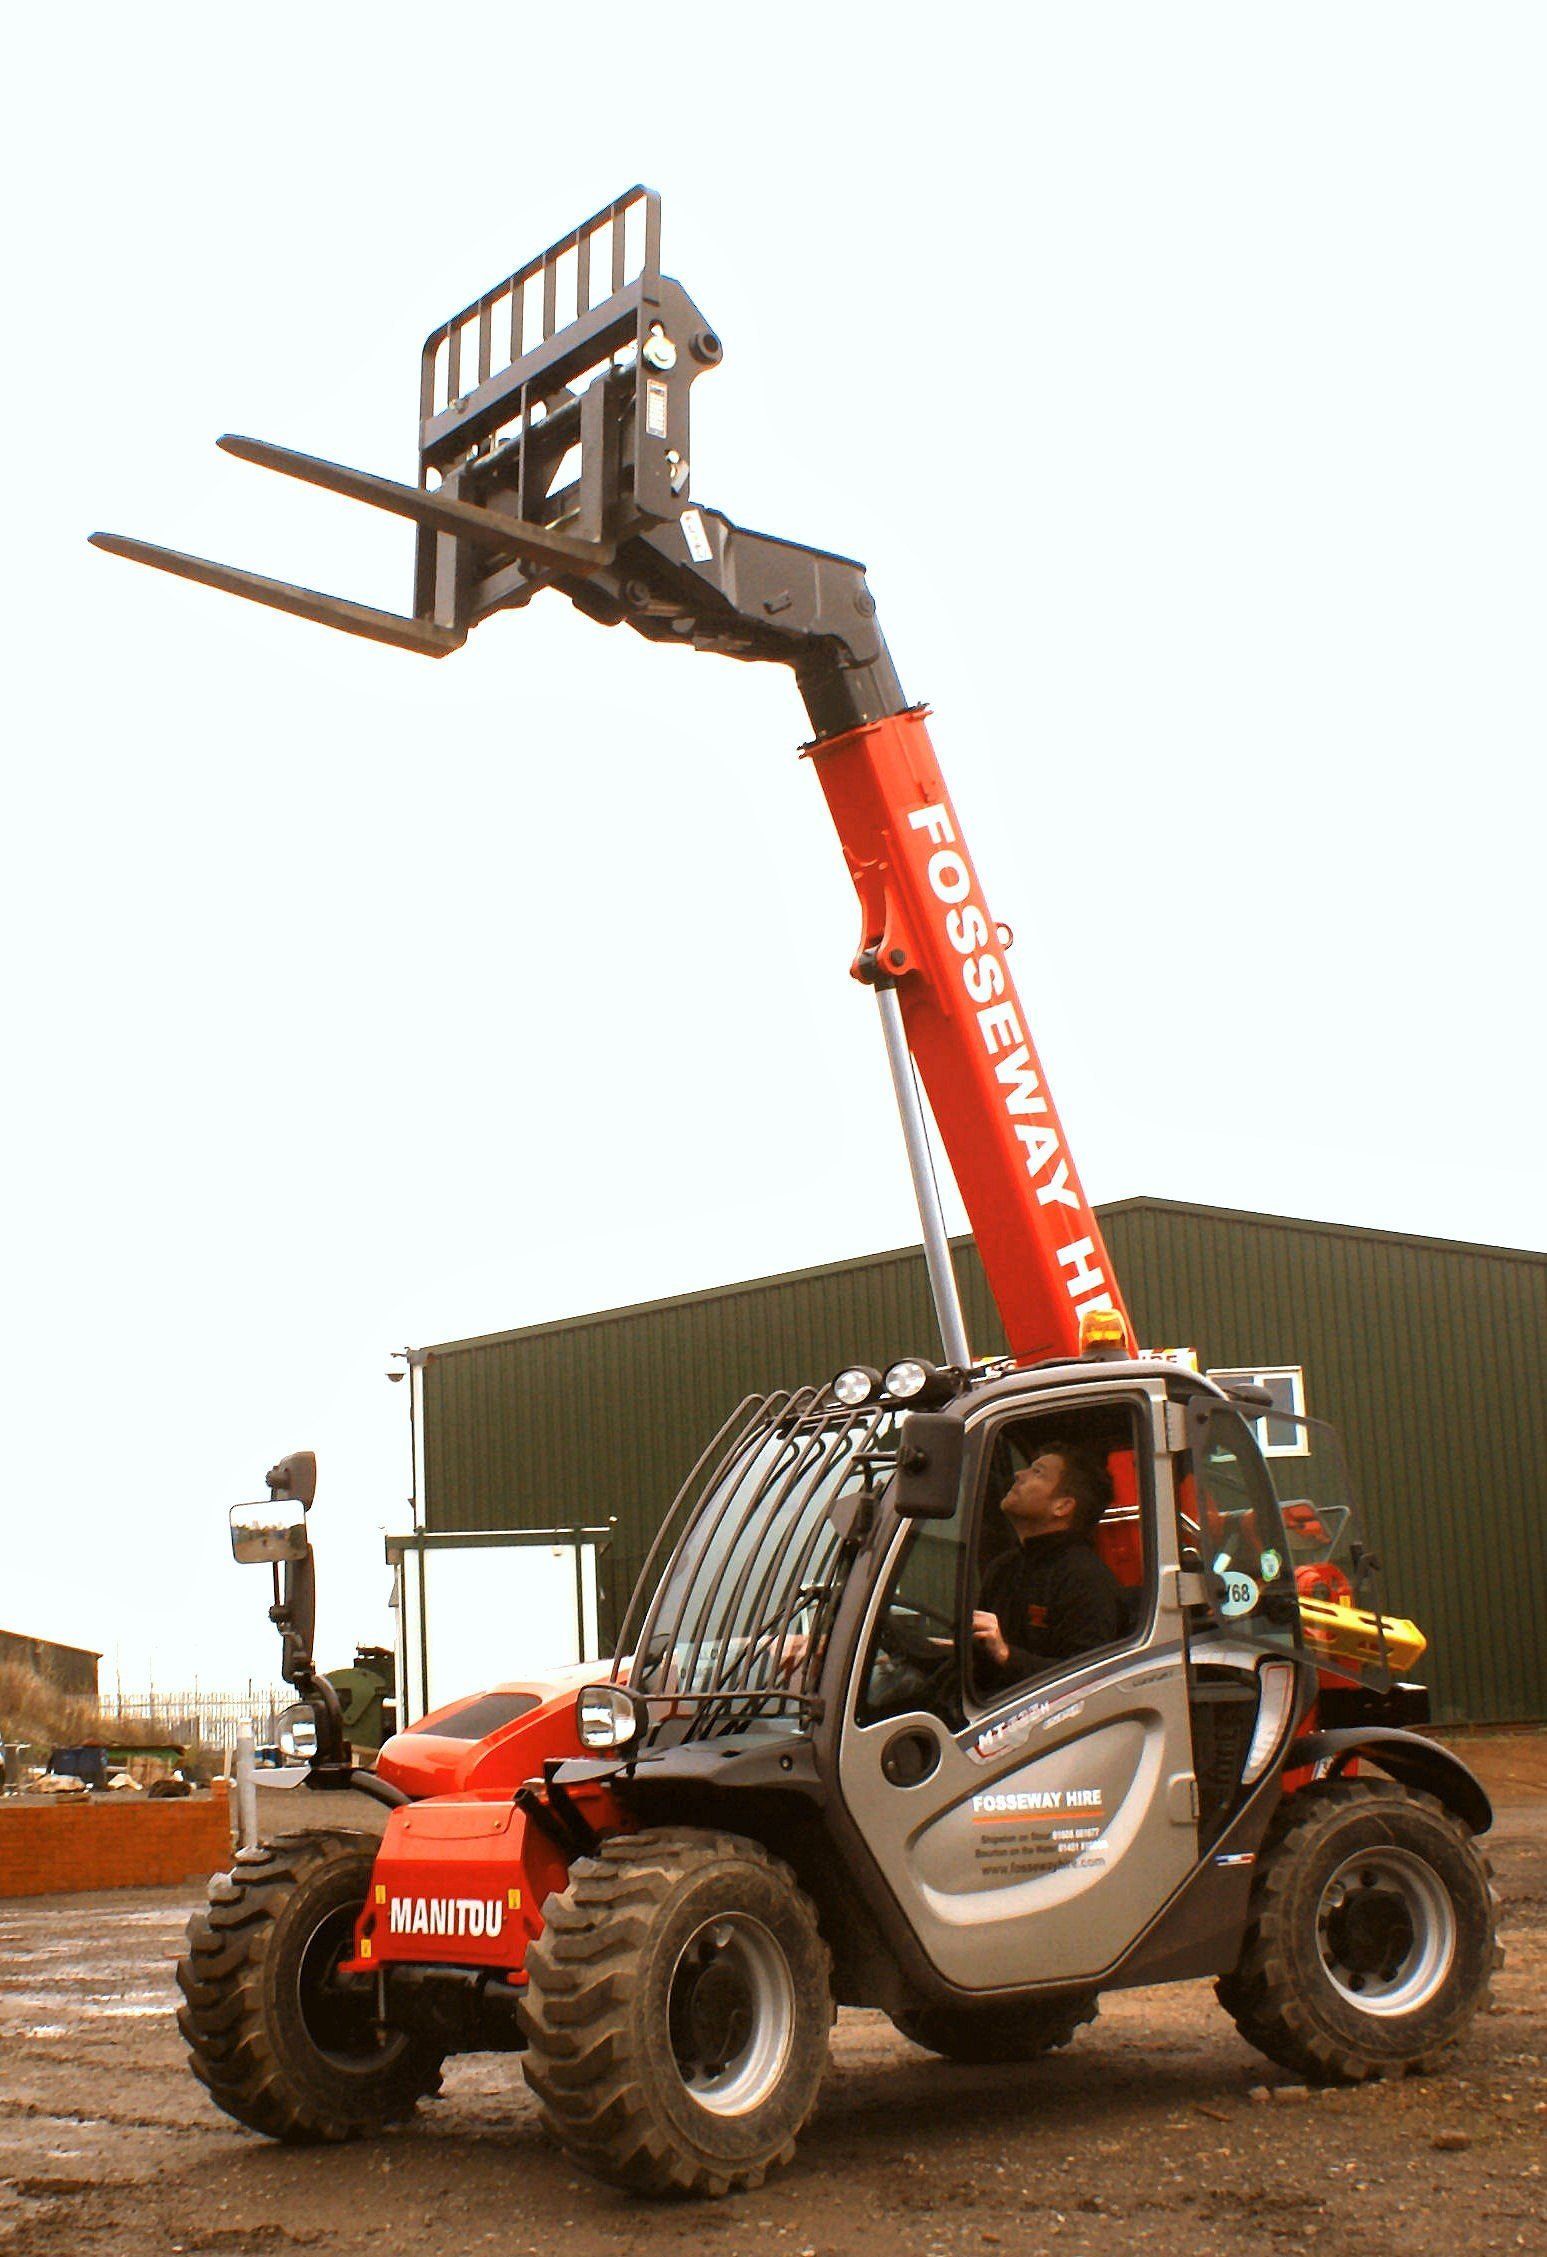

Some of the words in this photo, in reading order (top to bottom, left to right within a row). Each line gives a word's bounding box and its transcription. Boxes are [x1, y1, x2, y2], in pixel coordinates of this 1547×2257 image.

[907, 802, 1080, 1212] FOSSEWAY
[1056, 1236, 1115, 1323] HI
[972, 1791, 1062, 1812] FOSSEWAY
[1066, 1789, 1102, 1806] HIRE
[390, 1897, 502, 1937] MANITOU
